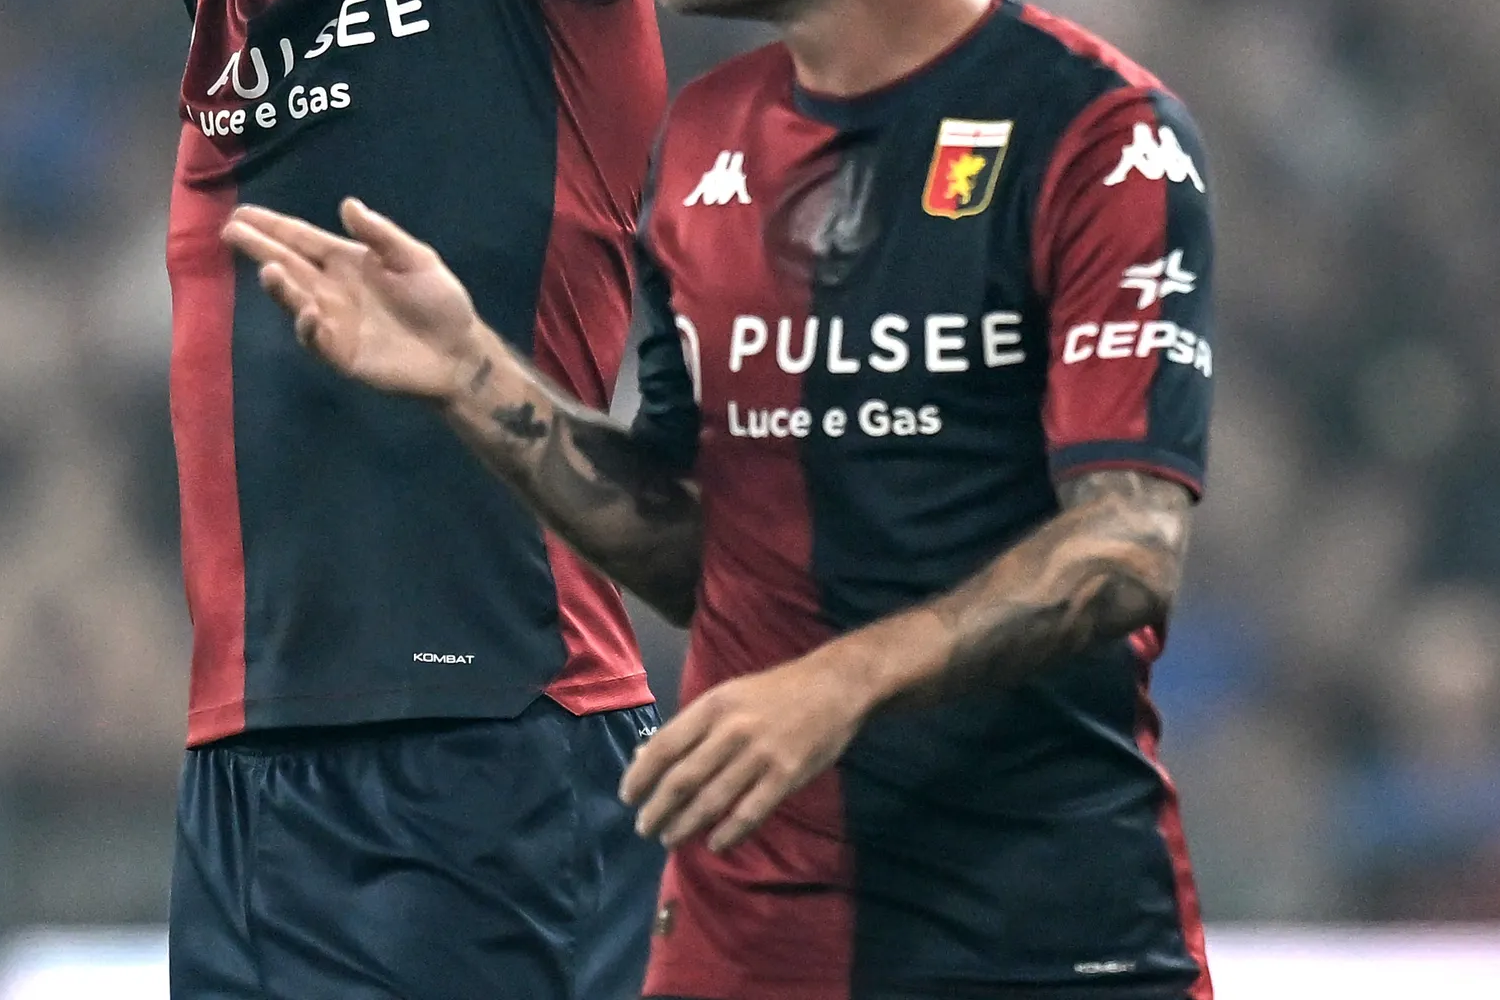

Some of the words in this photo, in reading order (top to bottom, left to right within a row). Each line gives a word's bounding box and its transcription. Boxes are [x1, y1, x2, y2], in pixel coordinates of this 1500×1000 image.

[186, 105, 247, 137] uce
[255, 102, 277, 129] e
[288, 82, 351, 119] Gas
[729, 310, 1026, 375] PULSEE
[1063, 320, 1213, 379] CEPSA
[727, 401, 812, 438] Luce
[822, 406, 848, 438] e
[857, 398, 943, 437] Gas
[413, 652, 476, 665] KOMBAT
